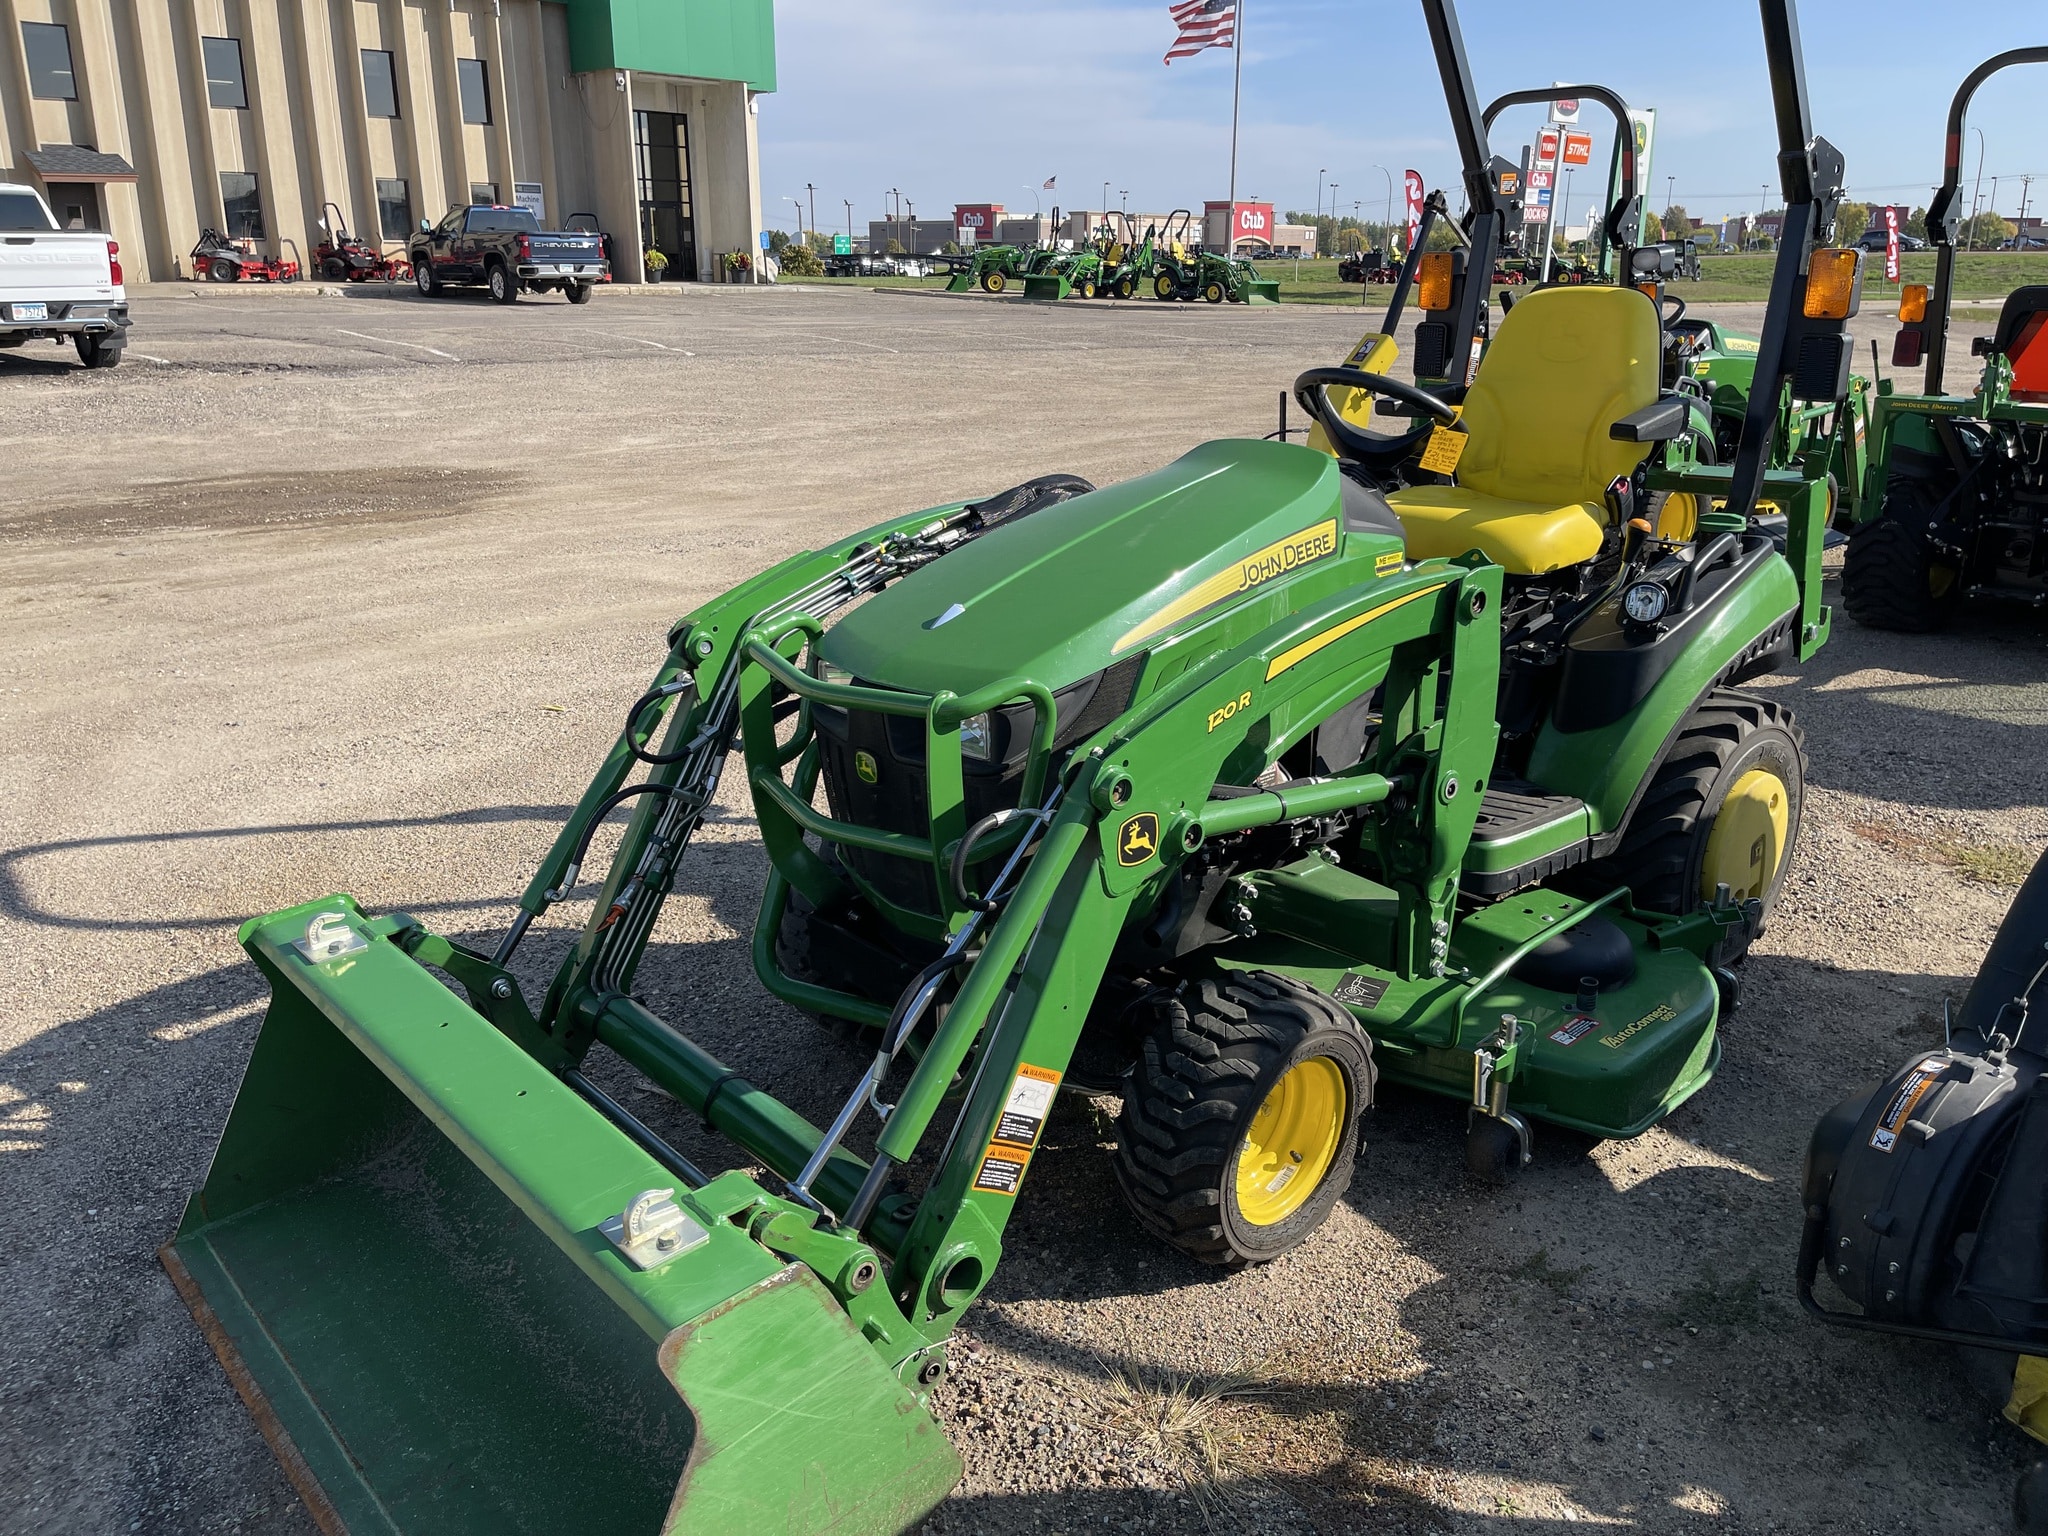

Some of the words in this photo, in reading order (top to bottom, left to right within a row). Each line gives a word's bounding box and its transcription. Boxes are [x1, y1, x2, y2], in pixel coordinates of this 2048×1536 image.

[1542, 143, 1555, 152] TORO
[1567, 143, 1589, 157] STIHL
[1532, 172, 1548, 186] Cub
[516, 195, 540, 203] Machine
[962, 212, 984, 227] Cub
[1241, 210, 1264, 230] Cub
[1524, 208, 1541, 220] DOCK
[1239, 554, 1281, 590] JOHN
[1284, 534, 1330, 566] DEERE
[1607, 1003, 1673, 1049] AutoConnect
[1029, 1069, 1056, 1080] WARNING
[1903, 1089, 1922, 1114] WARNING
[998, 1151, 1024, 1161] WARNING
